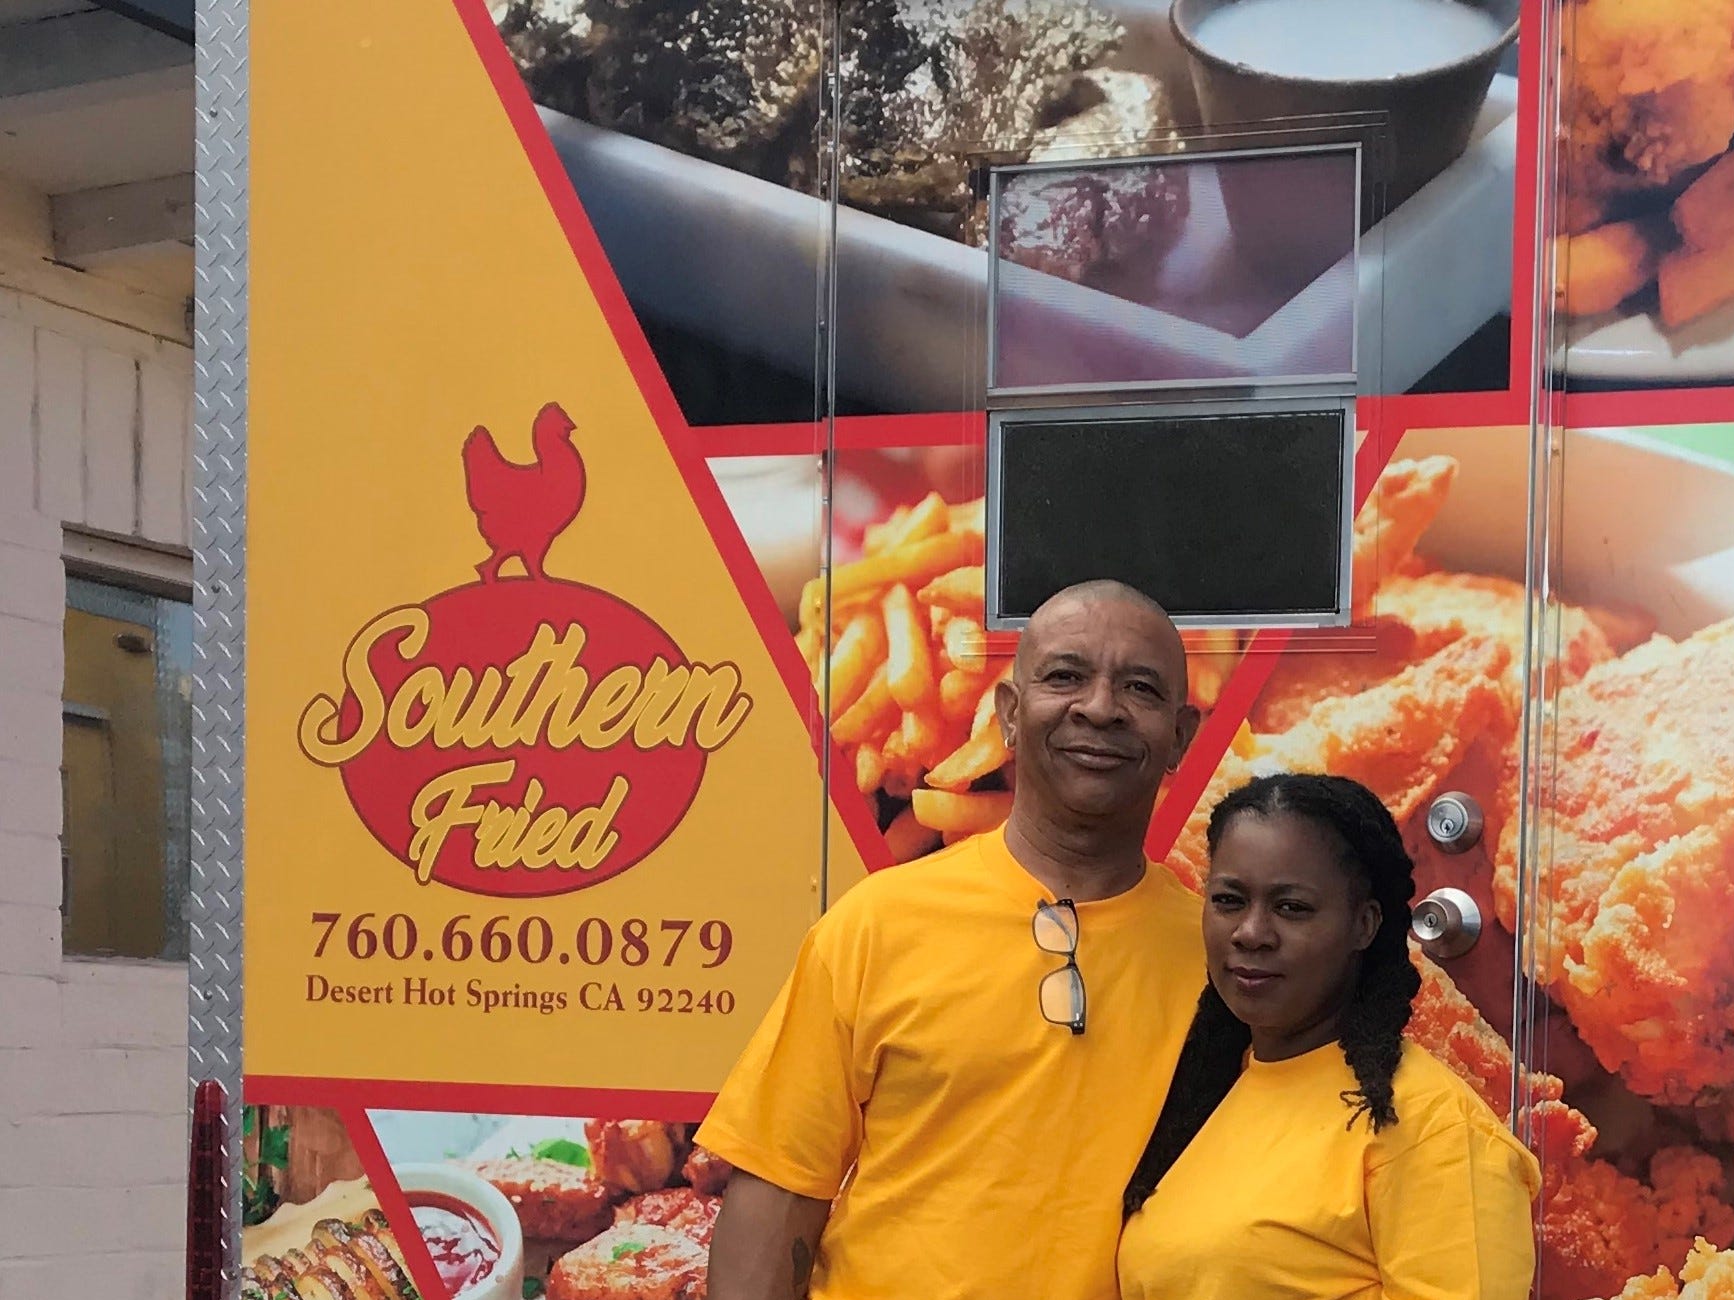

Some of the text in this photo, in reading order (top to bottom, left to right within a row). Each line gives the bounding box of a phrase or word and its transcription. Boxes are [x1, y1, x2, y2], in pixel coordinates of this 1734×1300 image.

[298, 603, 754, 768] Southern
[409, 757, 629, 886] Fried
[311, 911, 734, 970] 760.660.0879
[305, 974, 736, 1016] Desert Hot Springs CA 92240
